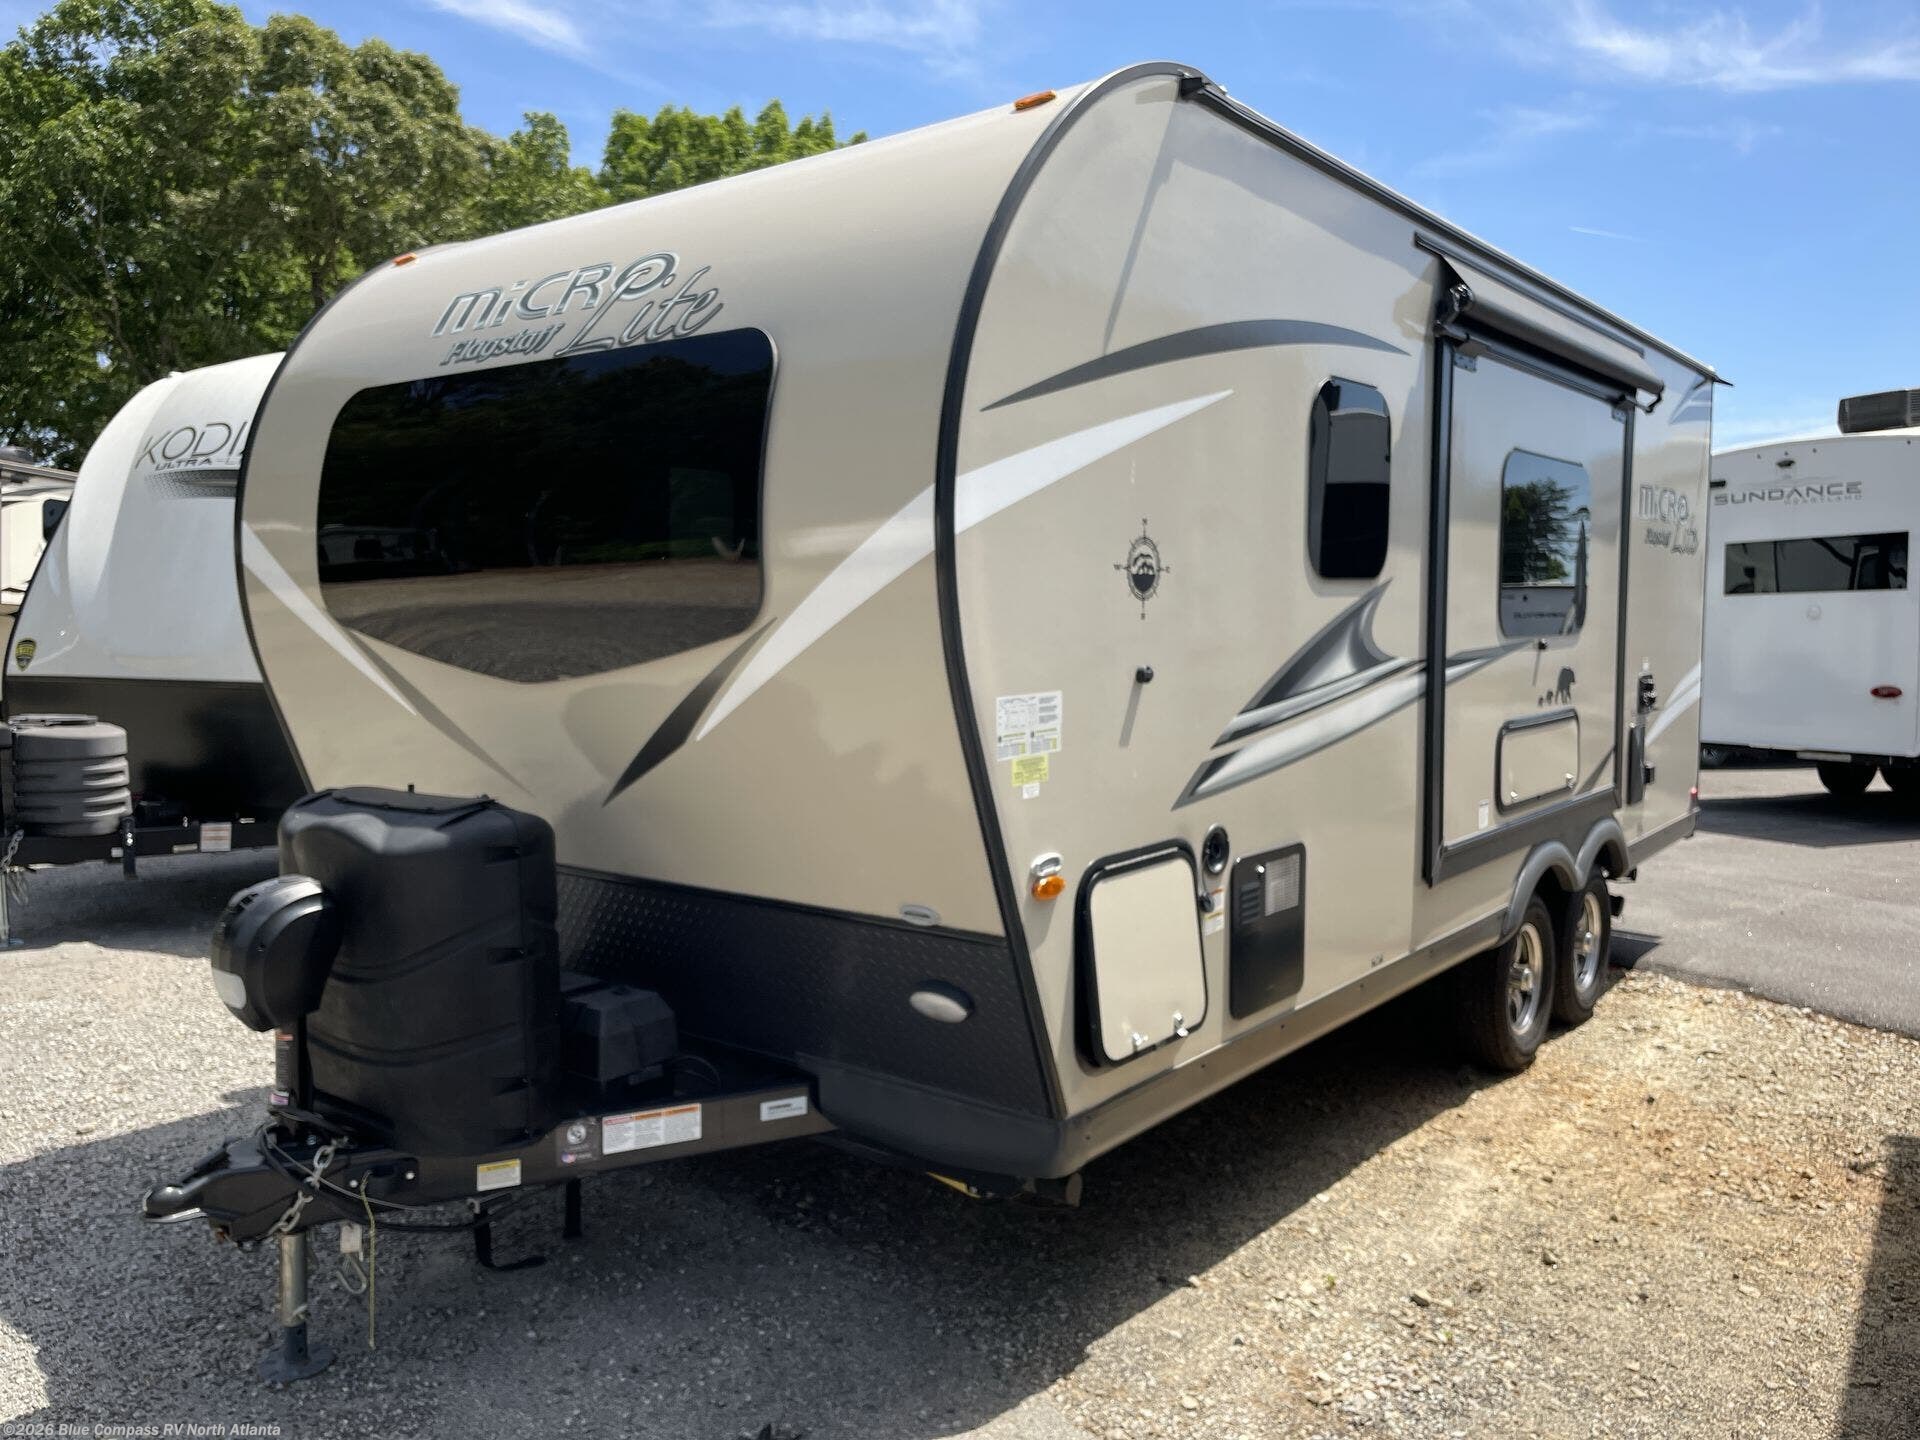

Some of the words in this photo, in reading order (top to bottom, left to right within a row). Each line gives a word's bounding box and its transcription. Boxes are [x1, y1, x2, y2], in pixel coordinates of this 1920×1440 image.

[439, 322, 565, 366] Flagstaff
[553, 264, 723, 357] Lite
[135, 421, 247, 470] KODI
[1714, 481, 1862, 506] SUNDANCE
